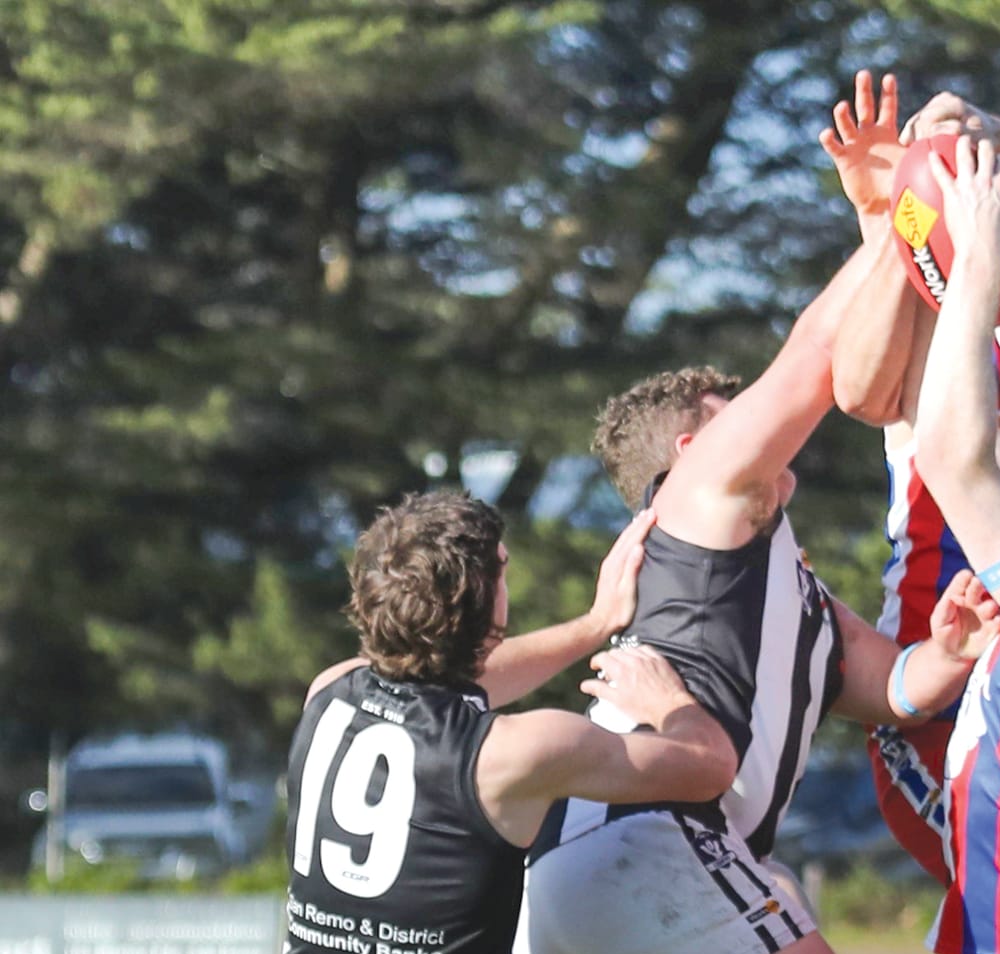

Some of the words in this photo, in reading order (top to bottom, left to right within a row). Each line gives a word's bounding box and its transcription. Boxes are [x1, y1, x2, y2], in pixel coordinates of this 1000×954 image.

[293, 698, 416, 898] 19
[305, 902, 355, 931] Remo
[360, 917, 374, 936] &
[379, 922, 444, 944] District
